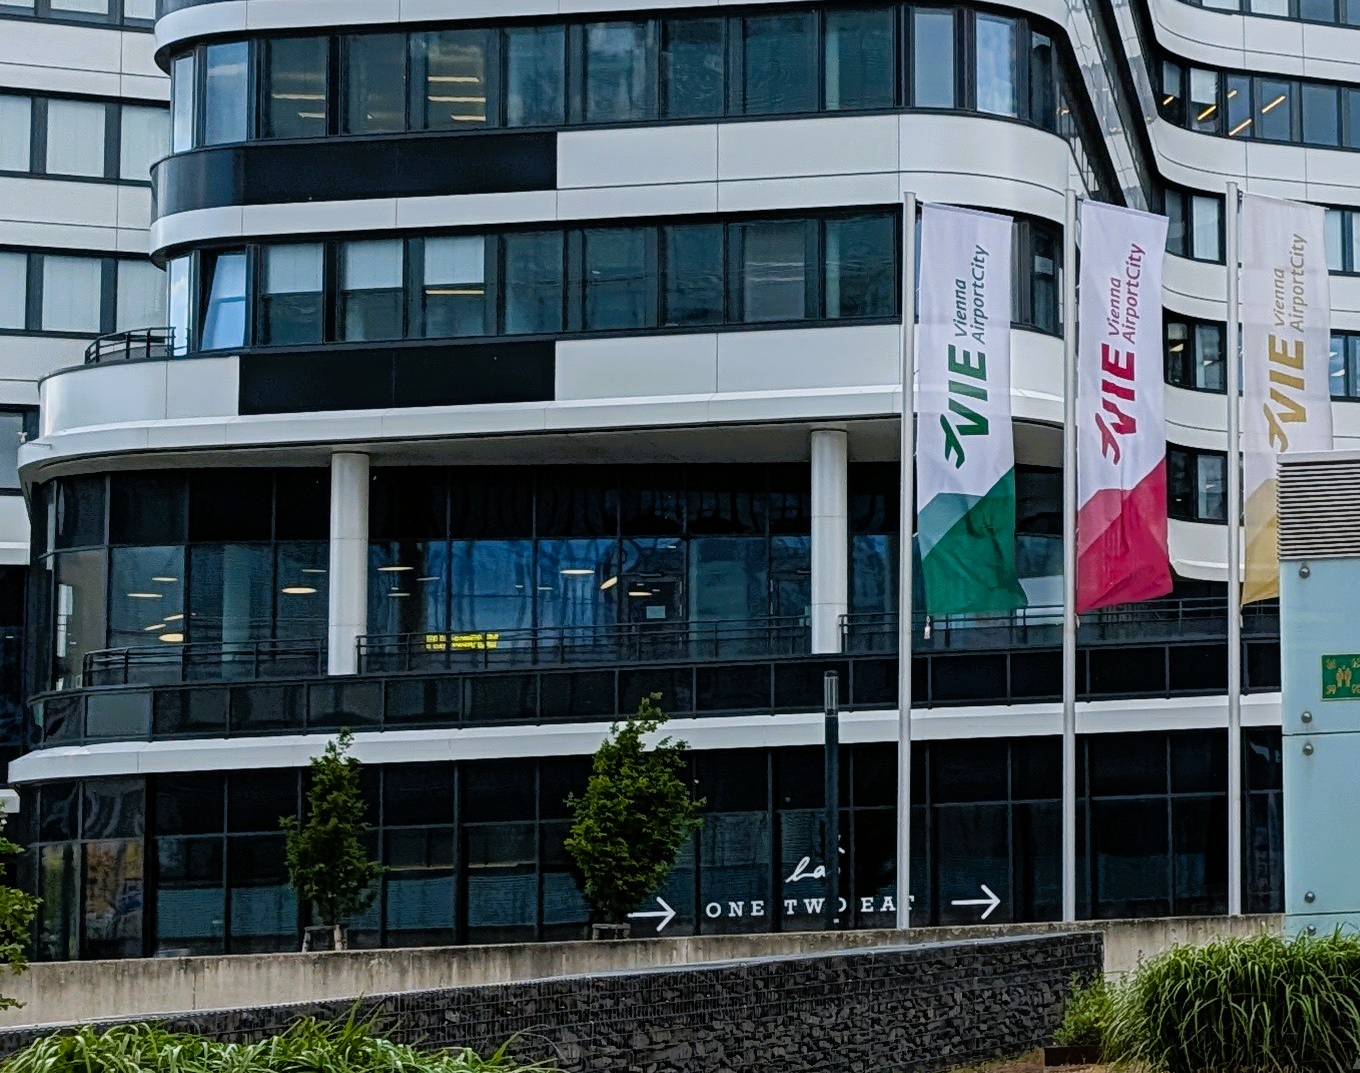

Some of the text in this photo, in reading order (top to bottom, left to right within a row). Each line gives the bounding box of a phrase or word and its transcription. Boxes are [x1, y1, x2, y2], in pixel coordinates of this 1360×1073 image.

[954, 278, 967, 337] Vienna
[970, 244, 990, 345] AirportCity
[1108, 277, 1122, 337] Vienna
[1122, 243, 1146, 345] AirportCity
[1274, 268, 1285, 327] Vienna
[1289, 233, 1307, 333] AirportCity
[948, 343, 990, 436] VIE
[1101, 343, 1137, 435] VIE
[1268, 333, 1307, 423] VIE
[705, 900, 765, 918] ONE
